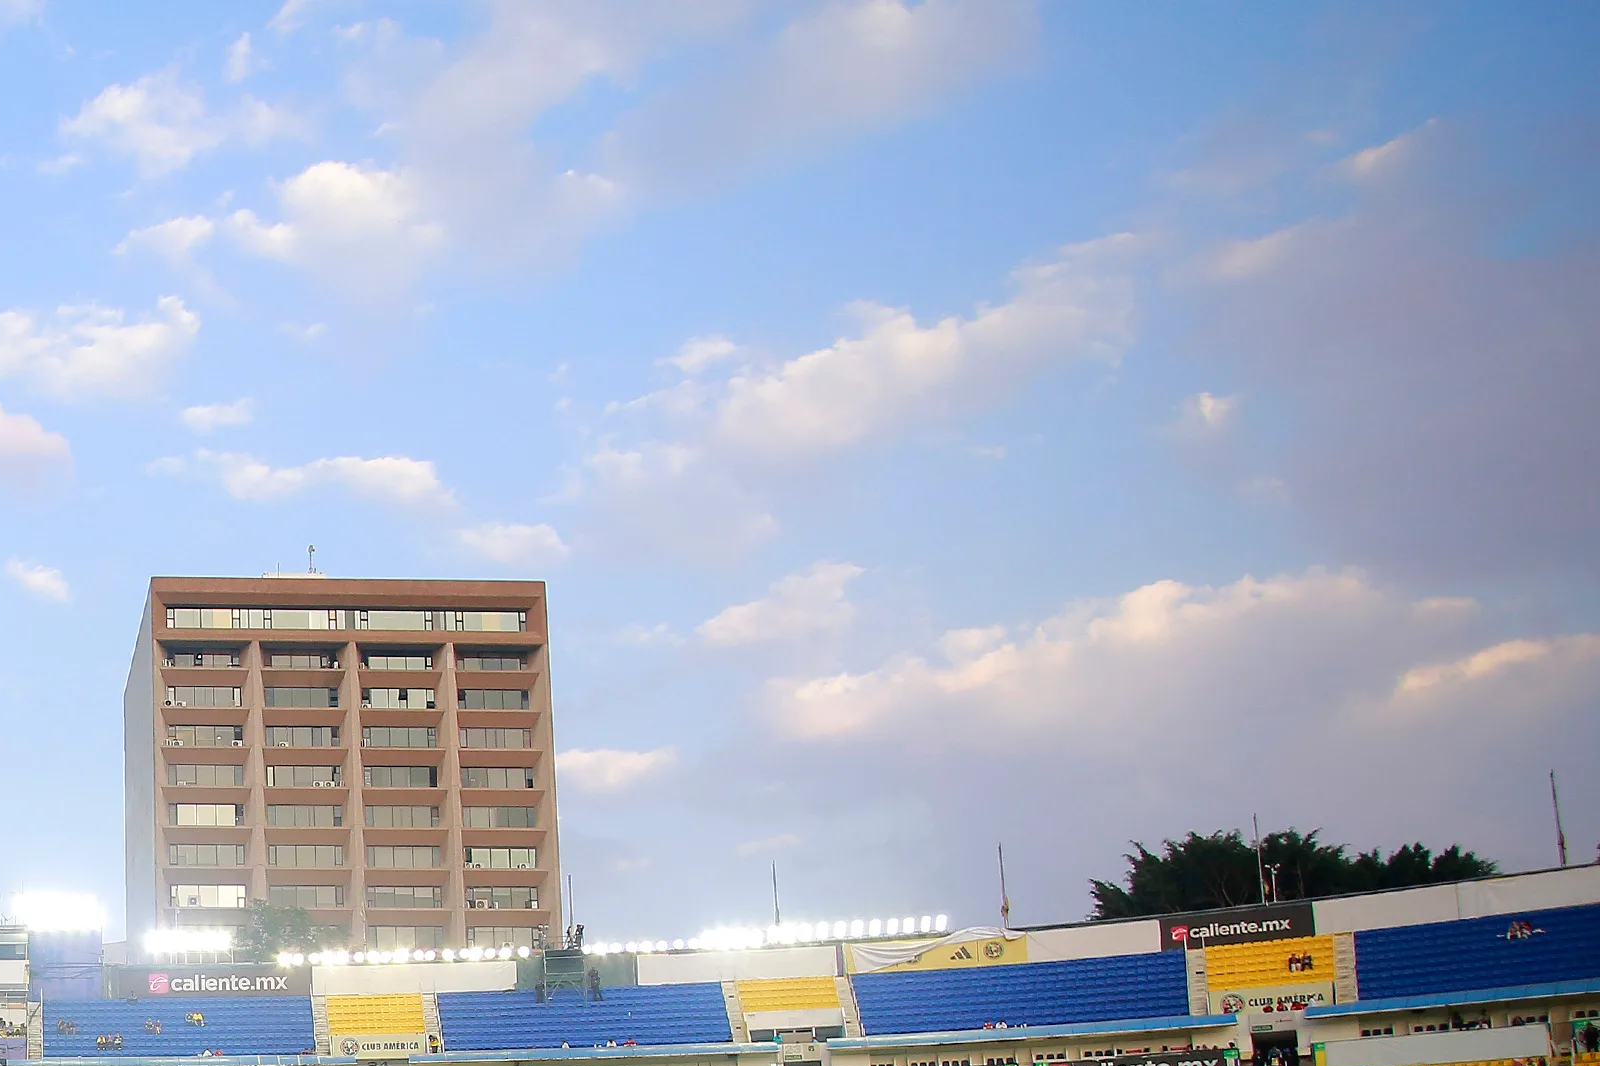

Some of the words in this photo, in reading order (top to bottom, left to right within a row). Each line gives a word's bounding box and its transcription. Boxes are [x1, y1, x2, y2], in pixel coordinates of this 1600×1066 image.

[1189, 918, 1291, 938] caliente.mx
[170, 974, 288, 992] caliente.mx
[361, 1042, 381, 1051] CLUB
[383, 1040, 420, 1050] AMÉRICA
